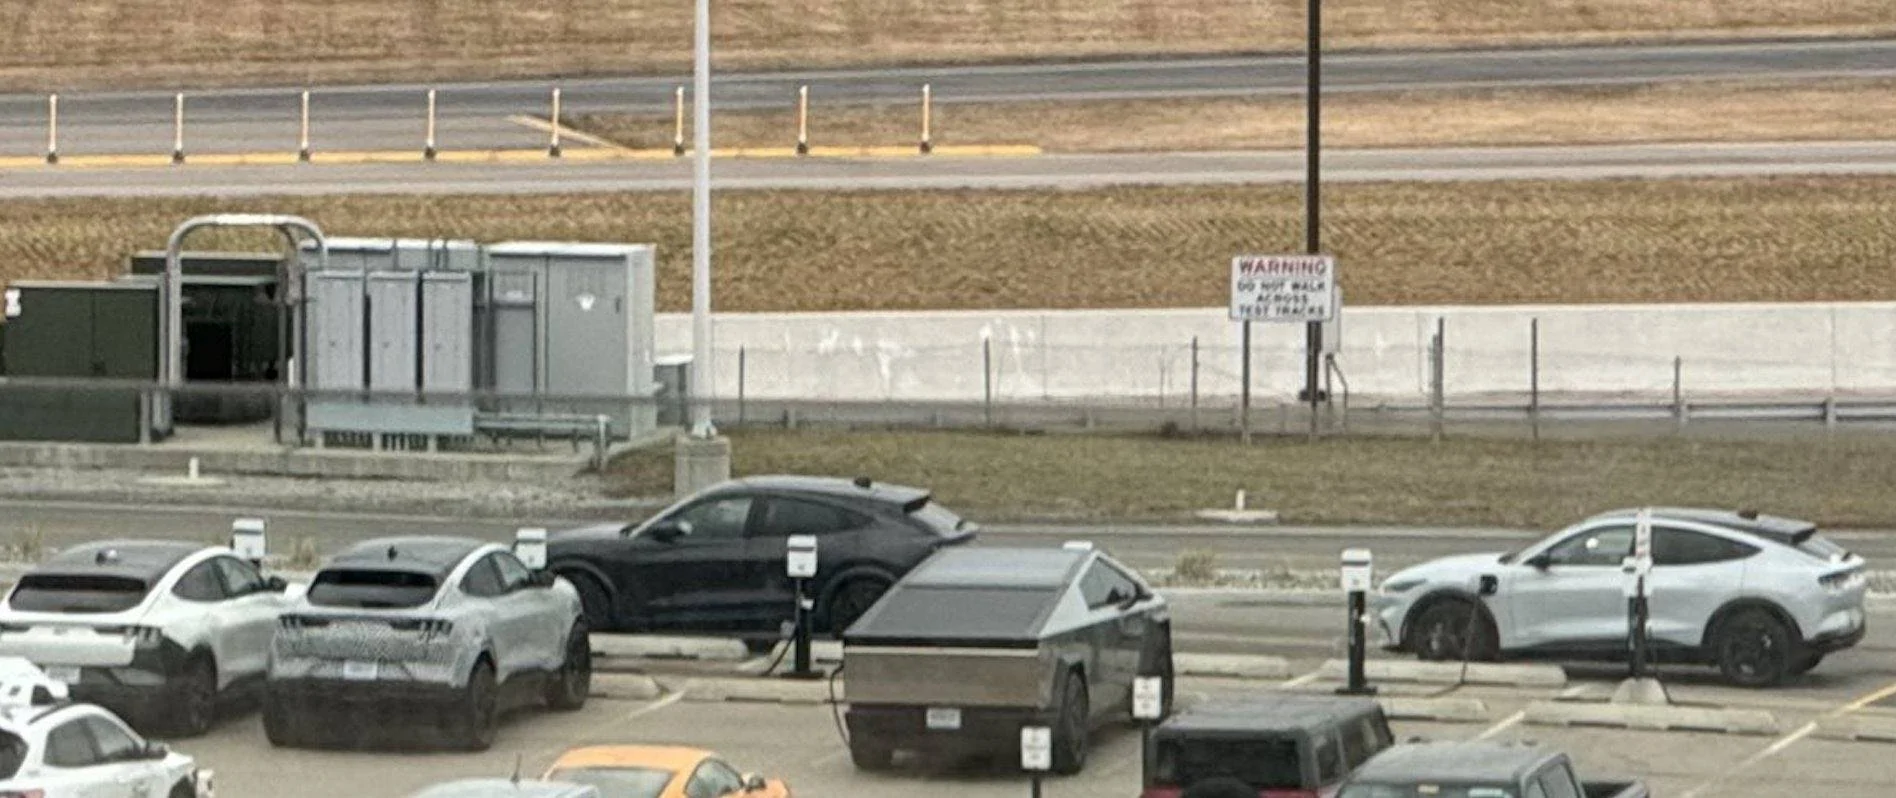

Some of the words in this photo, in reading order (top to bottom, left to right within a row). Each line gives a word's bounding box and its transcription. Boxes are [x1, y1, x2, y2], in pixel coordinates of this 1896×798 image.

[1240, 259, 1327, 275] WARNING
[1238, 281, 1255, 292] DO
[1261, 281, 1285, 292] NOT
[1291, 281, 1325, 292] WALK
[1257, 293, 1308, 304] ACROSS
[1240, 305, 1268, 316] TEST
[1276, 305, 1324, 316] TRACKS
